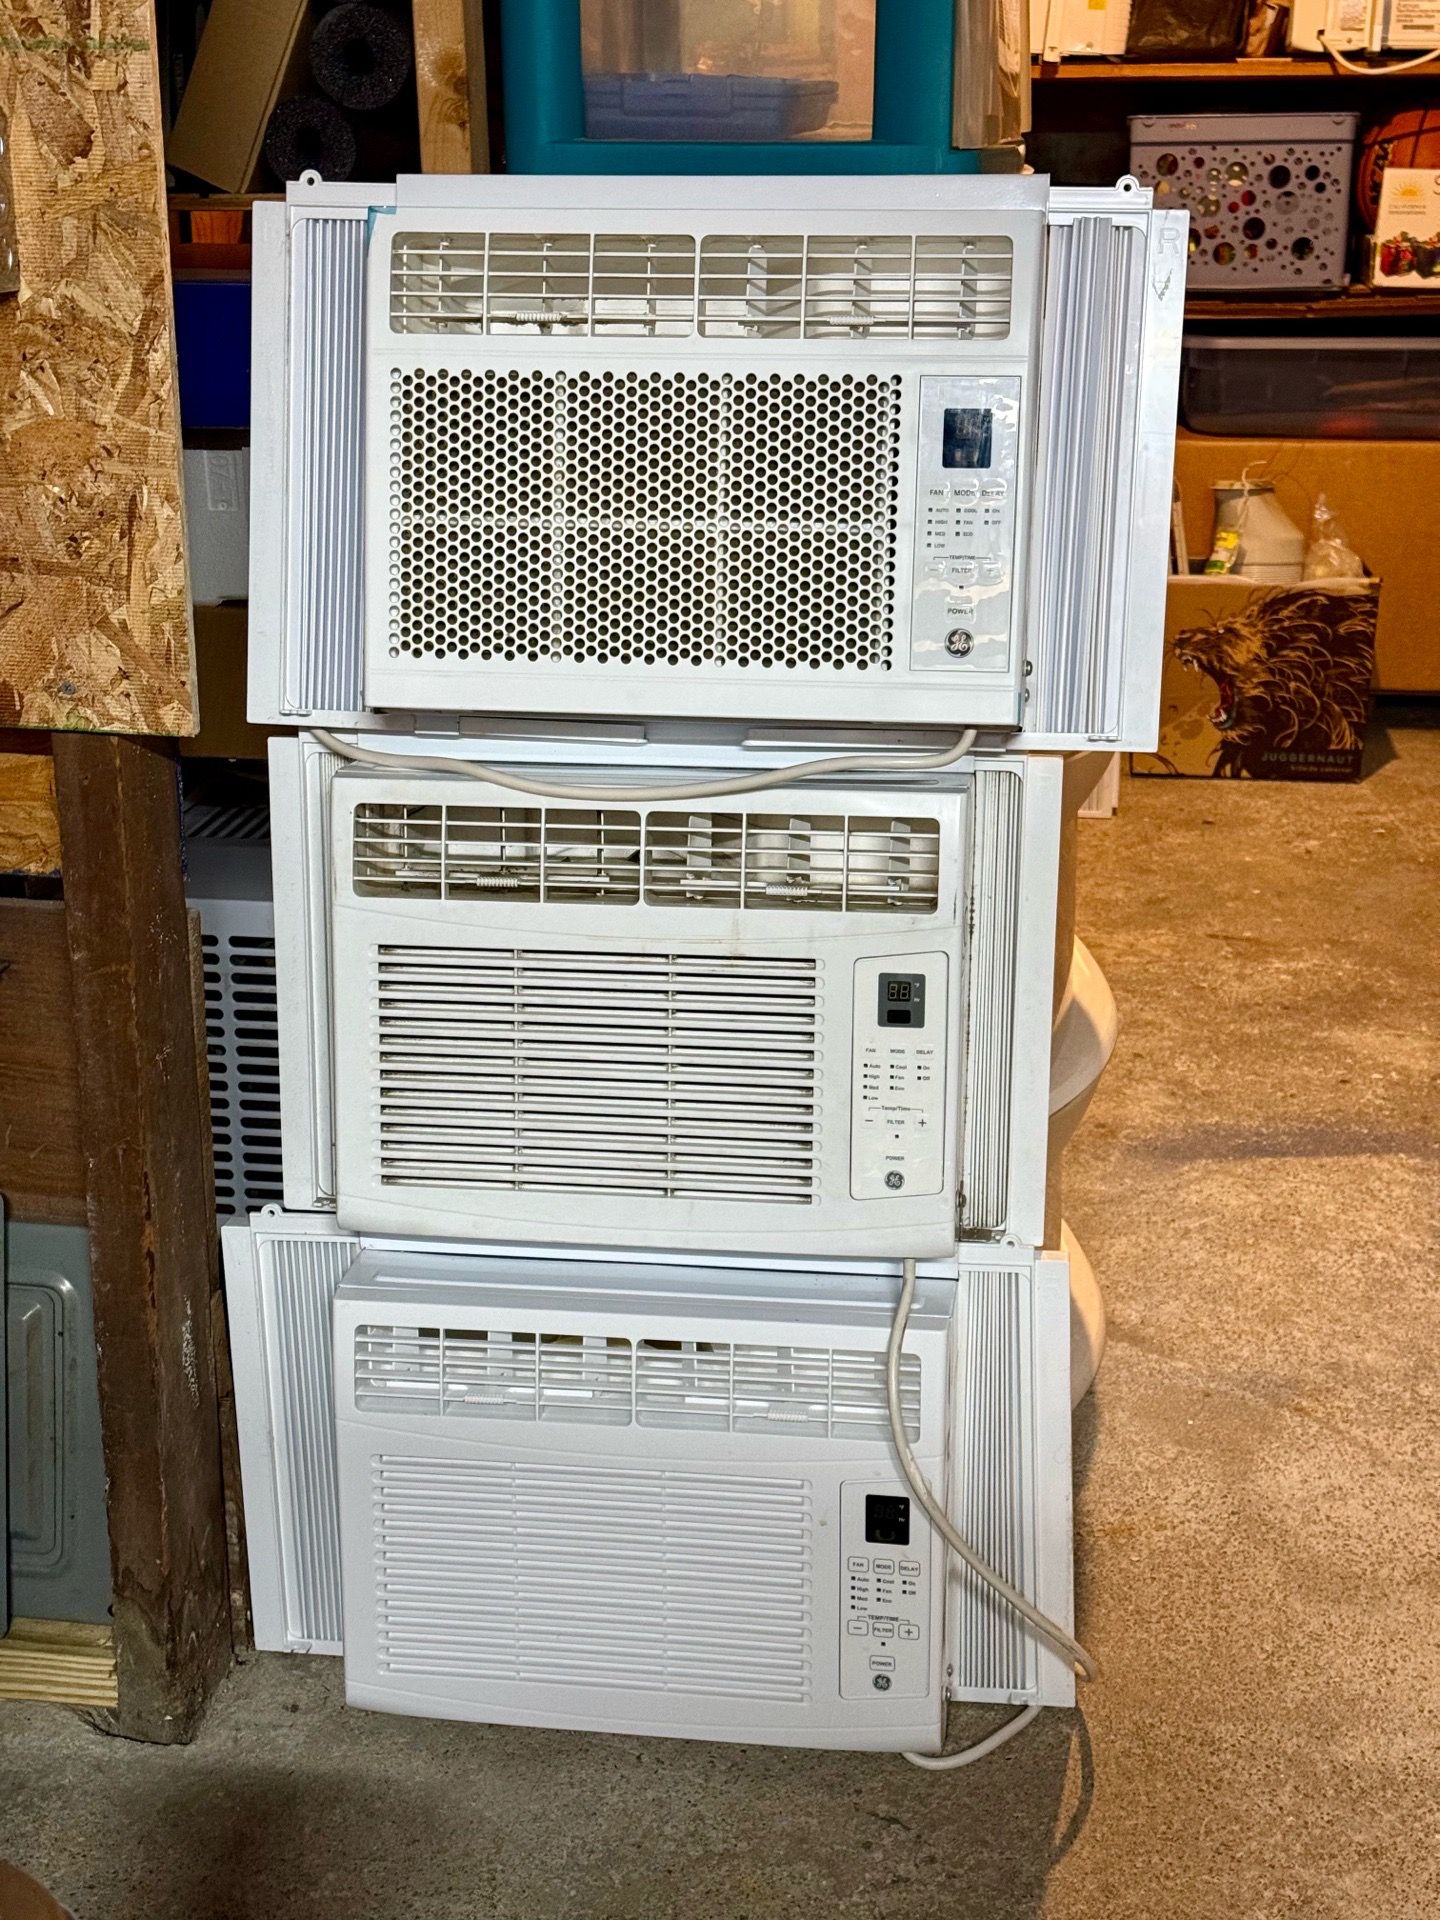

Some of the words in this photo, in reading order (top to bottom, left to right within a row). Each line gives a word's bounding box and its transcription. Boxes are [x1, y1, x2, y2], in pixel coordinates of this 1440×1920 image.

[1158, 227, 1181, 254] R
[1262, 752, 1353, 764] JUGGERNAUT
[868, 1614, 899, 1622] TEMP/TIME
